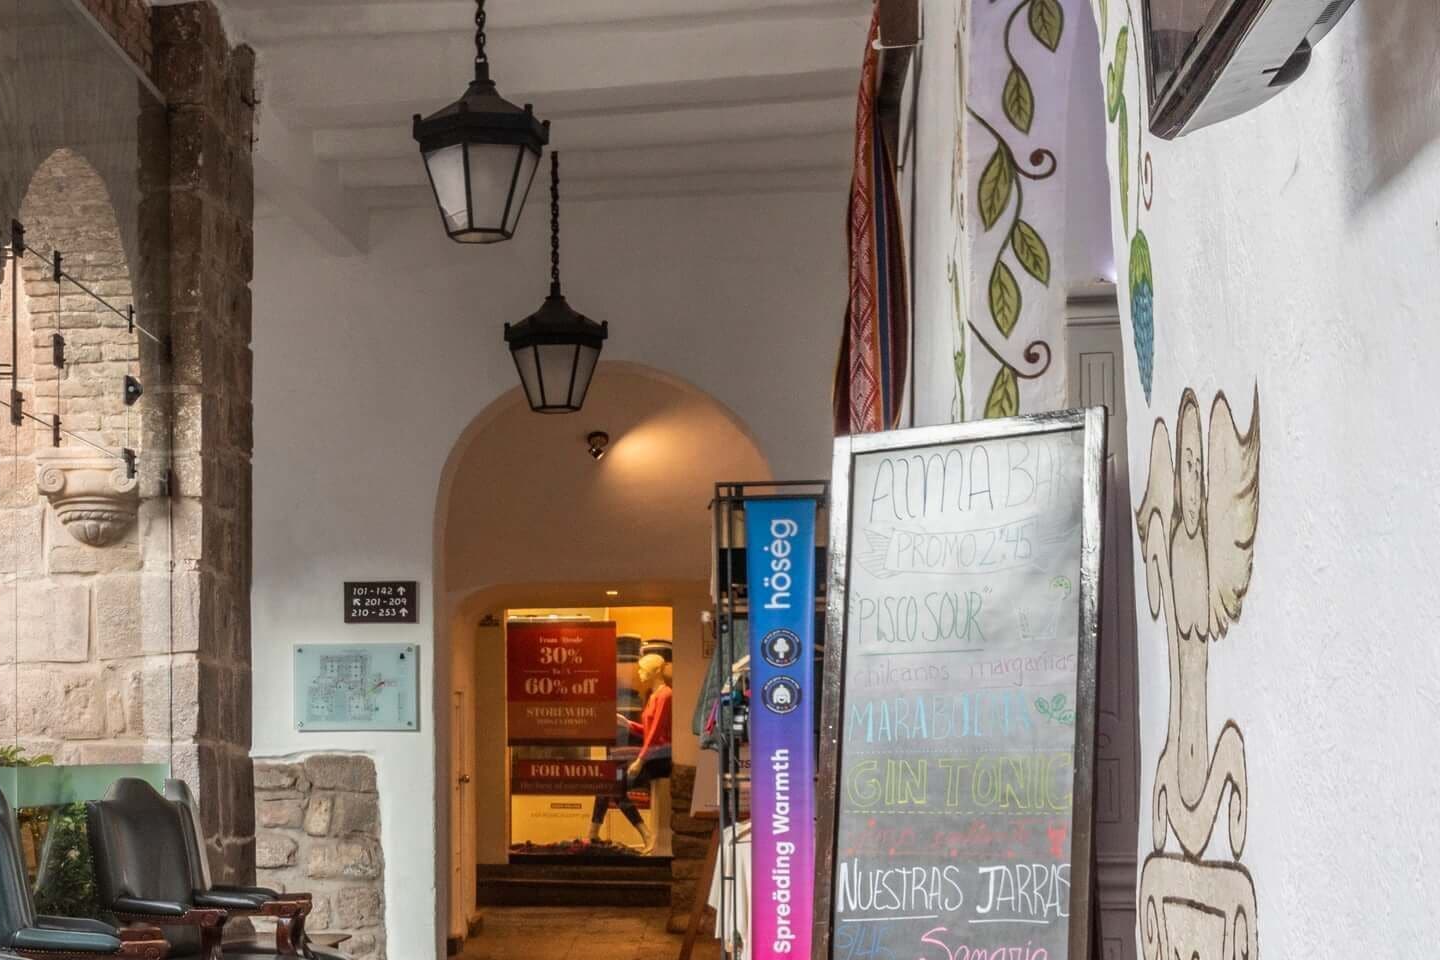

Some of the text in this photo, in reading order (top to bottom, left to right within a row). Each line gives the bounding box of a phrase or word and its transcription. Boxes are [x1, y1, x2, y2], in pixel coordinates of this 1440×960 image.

[895, 533, 977, 568] PROMO
[351, 609, 369, 617] 210
[540, 647, 583, 664] 30%
[525, 678, 599, 694] 60% off
[530, 764, 560, 777] FOR
[847, 754, 1073, 810] GIN TONIC
[770, 749, 796, 953] Spreäding Warmth
[837, 858, 1071, 918] NUESTRAS JARRAS
